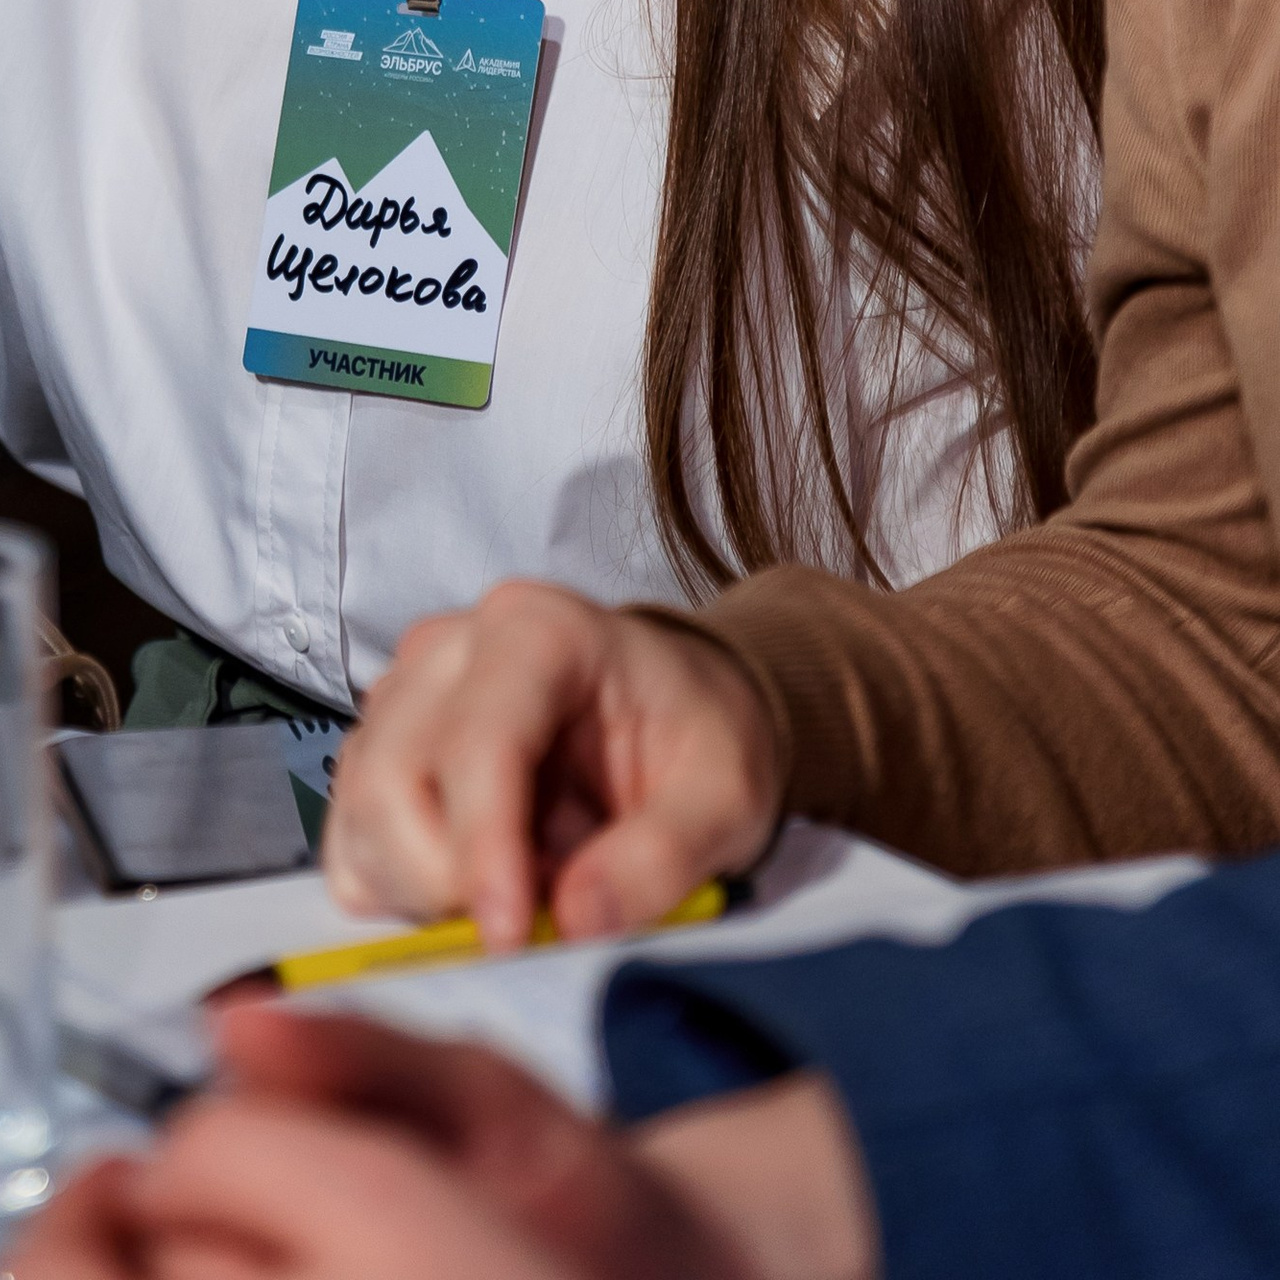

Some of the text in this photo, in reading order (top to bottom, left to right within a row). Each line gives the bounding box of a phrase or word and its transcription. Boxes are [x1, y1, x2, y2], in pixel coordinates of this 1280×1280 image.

[380, 55, 443, 76] ЭЛЬБРУС
[477, 65, 522, 79] ЛИДЕРСТВА
[478, 57, 521, 70] АКАДЕМИЯ
[302, 173, 452, 249] Дарья
[267, 233, 487, 313] Щелокова
[308, 348, 427, 387] УЧАСТНИК
